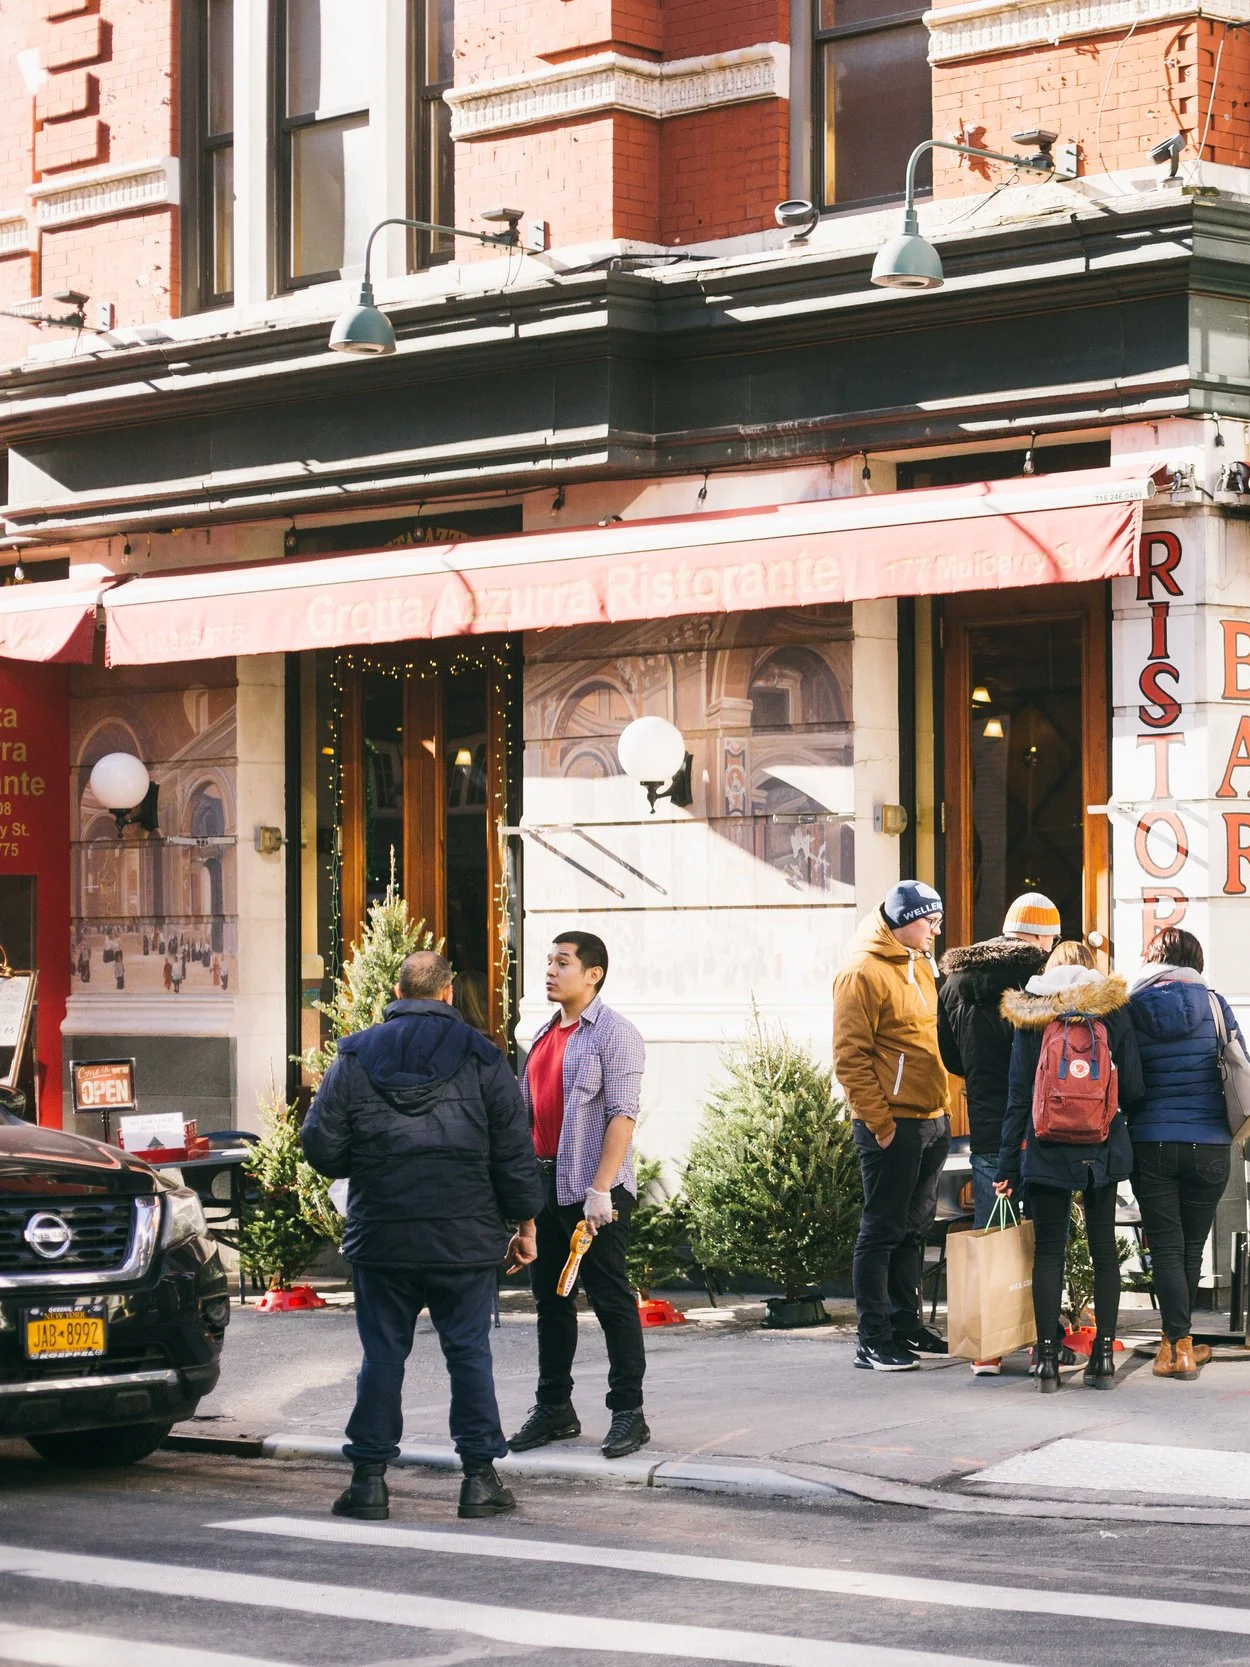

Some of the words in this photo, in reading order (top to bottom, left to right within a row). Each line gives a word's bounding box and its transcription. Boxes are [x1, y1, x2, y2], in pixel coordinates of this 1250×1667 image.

[304, 592, 427, 639] Grotta
[434, 578, 597, 636] Azzurra
[606, 549, 842, 615] Ristorante
[888, 557, 930, 585] 177
[11, 822, 30, 837] St.
[81, 1079, 129, 1104] OPEN
[31, 1231, 70, 1241] NISSAN
[44, 1311, 63, 1320] NEW
[65, 1310, 86, 1319] YORK
[40, 1351, 95, 1359] KOEPPEL
